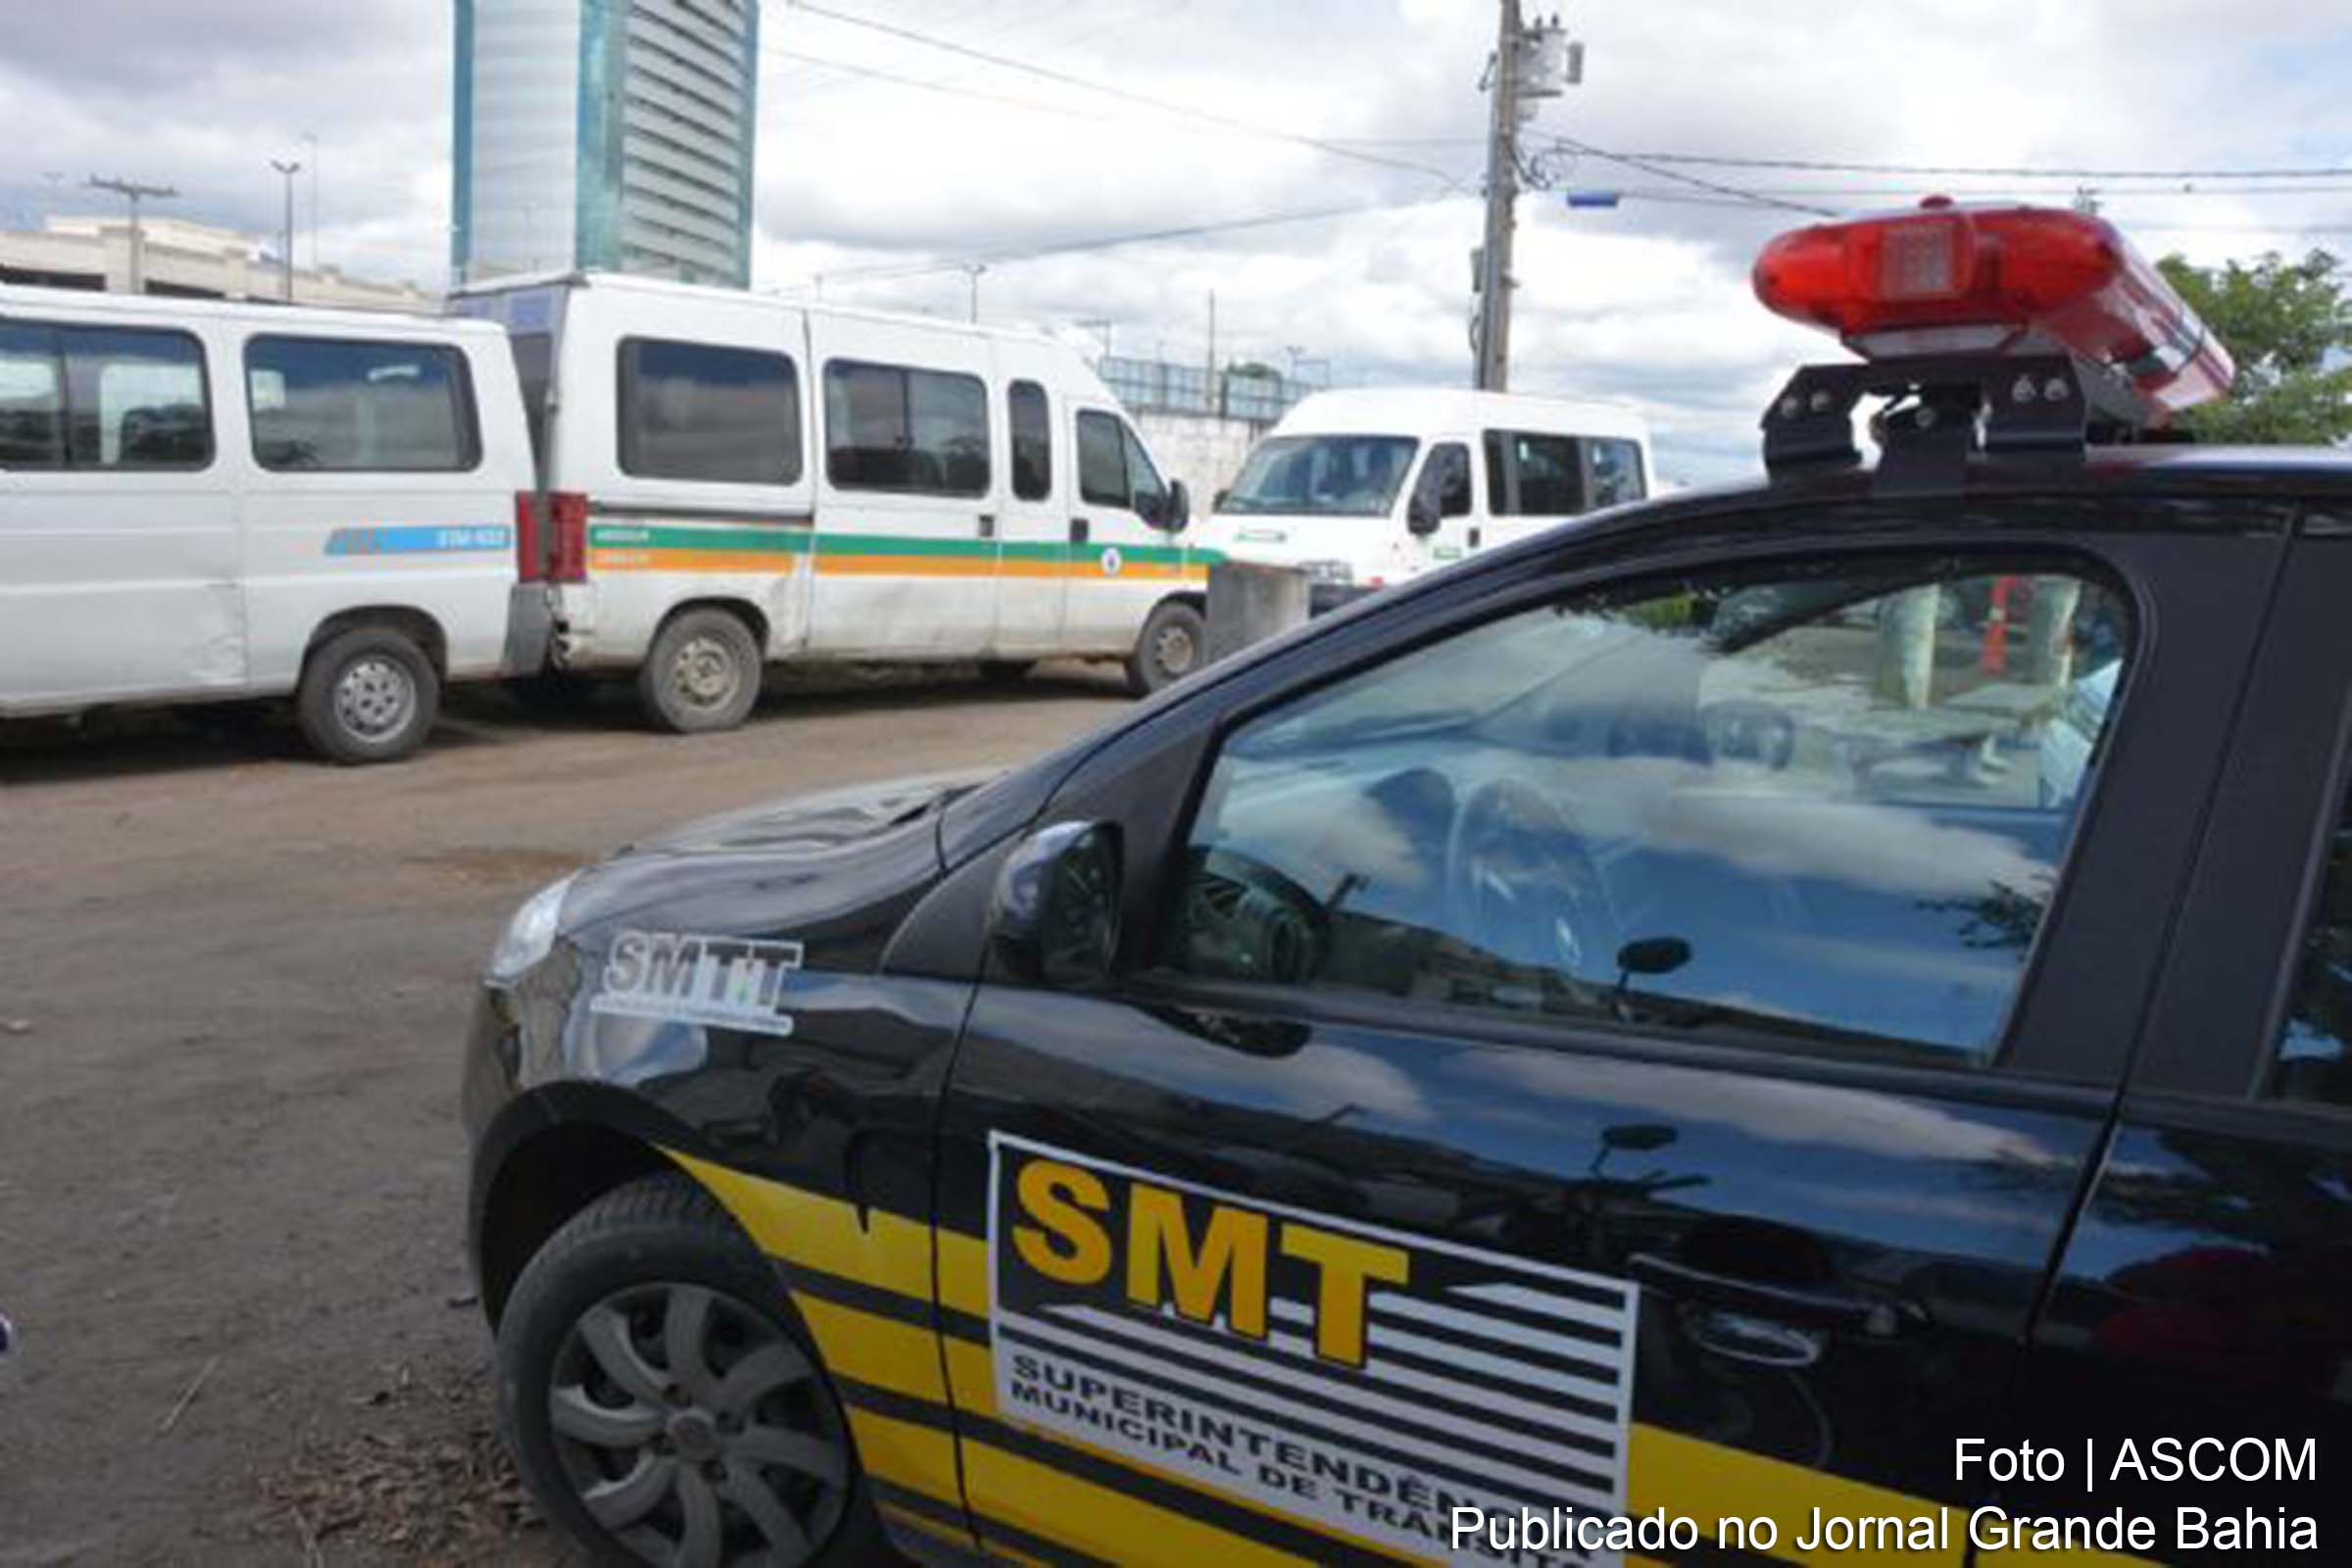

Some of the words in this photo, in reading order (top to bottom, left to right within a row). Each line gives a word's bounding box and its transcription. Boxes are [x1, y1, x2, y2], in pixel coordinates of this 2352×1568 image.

[602, 930, 805, 1009] SMTT
[1012, 1158, 1409, 1369] SMT
[1011, 1380, 1241, 1475] MUNICIPAL
[1258, 1463, 1319, 1501] DE
